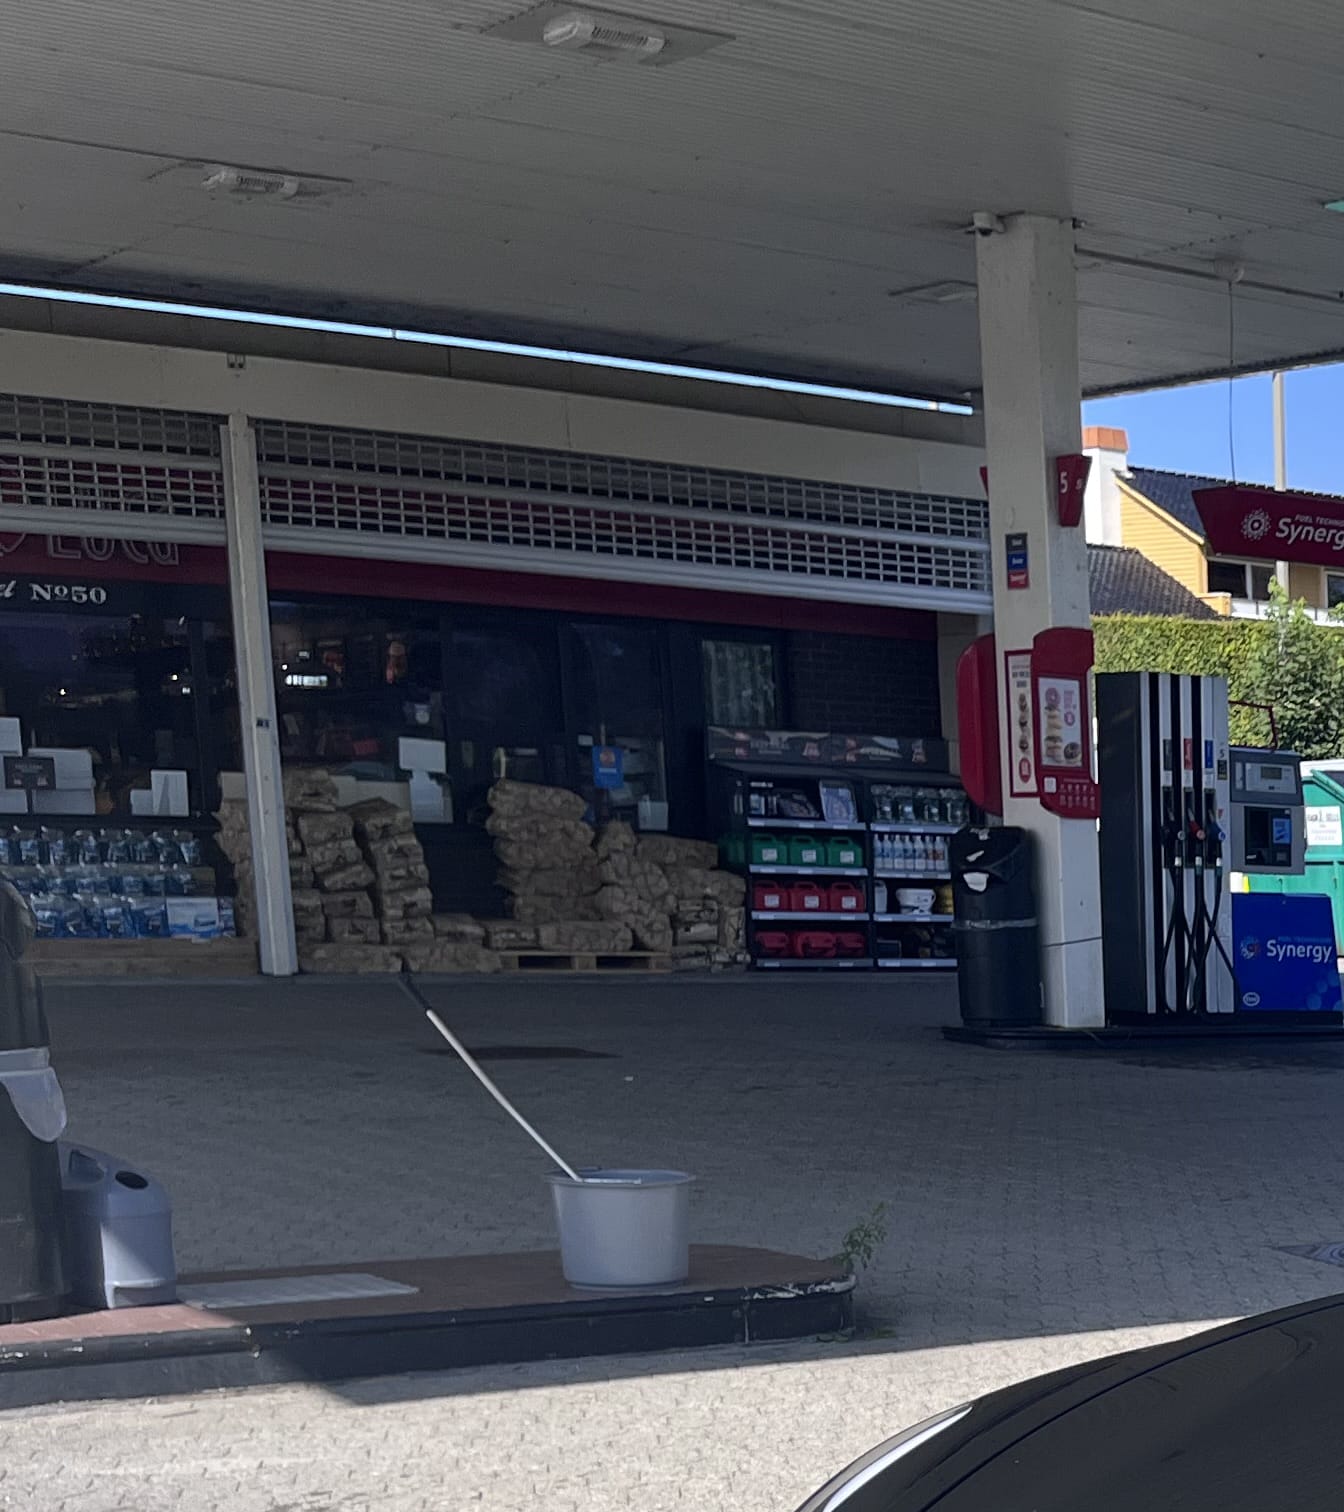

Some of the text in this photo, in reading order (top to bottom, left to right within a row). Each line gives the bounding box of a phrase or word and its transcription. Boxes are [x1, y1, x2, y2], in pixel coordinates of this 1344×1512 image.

[1060, 471, 1068, 494] 5
[1294, 513, 1313, 524] FUEL
[1266, 939, 1333, 964] Synergy
